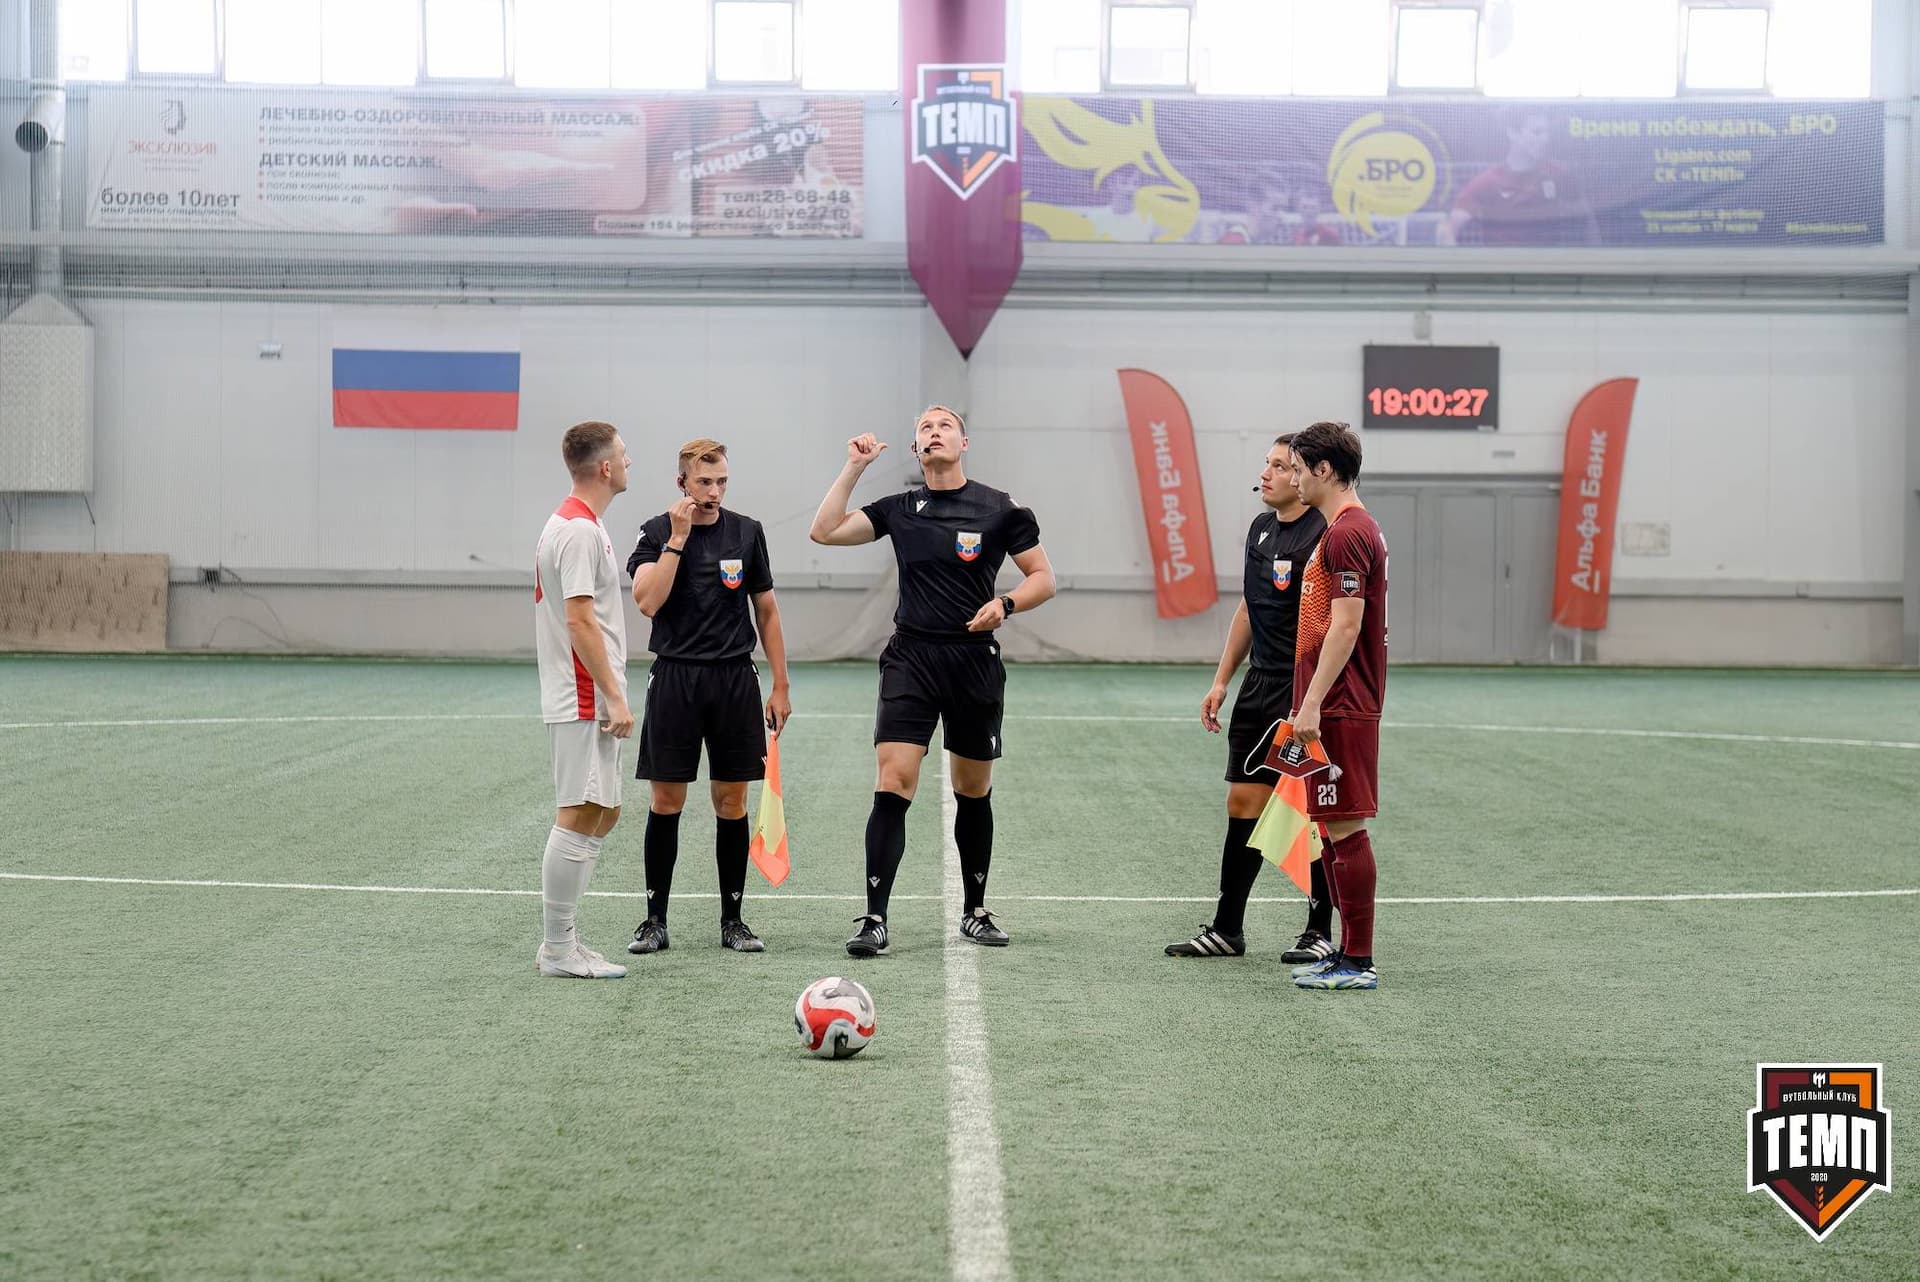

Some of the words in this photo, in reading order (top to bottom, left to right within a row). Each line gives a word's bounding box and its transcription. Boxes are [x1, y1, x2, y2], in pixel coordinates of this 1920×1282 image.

[922, 102, 1006, 148] ТЕМП
[1570, 117, 1640, 139] Время
[259, 151, 347, 168] ДЕТСКИЙ
[677, 143, 769, 183] скидка
[773, 120, 831, 154] 20%
[1358, 159, 1425, 181] .БРО
[101, 187, 169, 206] более
[1368, 387, 1489, 417] 19:00:27
[1580, 428, 1609, 498] Банк
[1571, 502, 1601, 593] Альфа
[1317, 784, 1338, 806] 23
